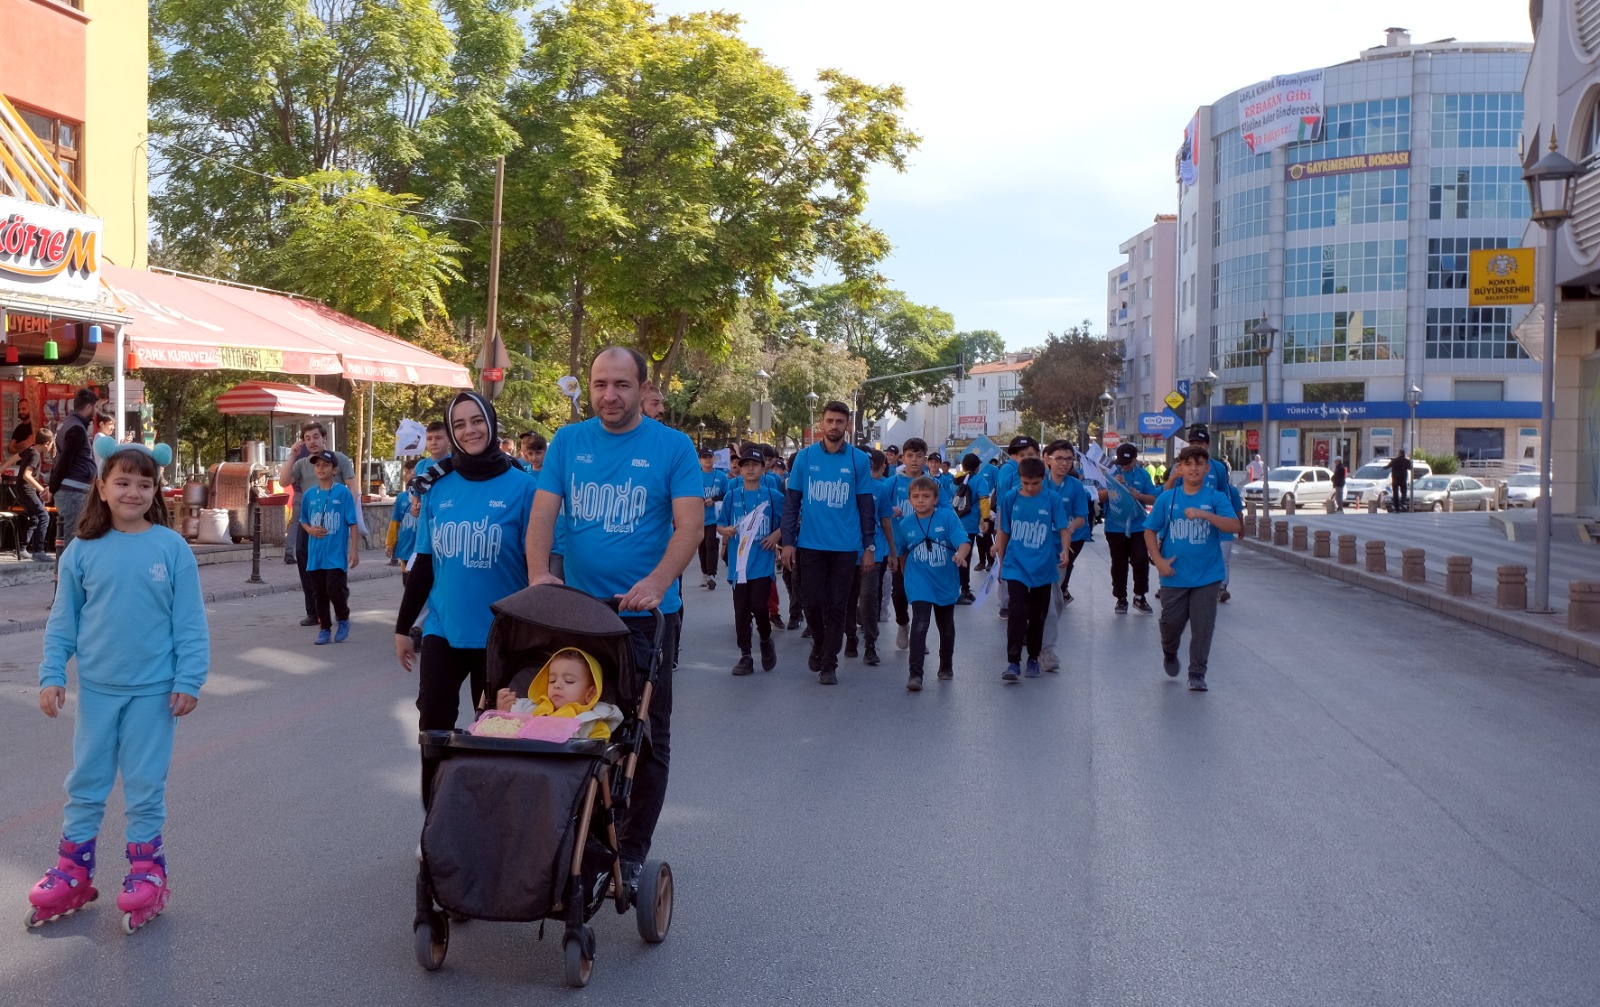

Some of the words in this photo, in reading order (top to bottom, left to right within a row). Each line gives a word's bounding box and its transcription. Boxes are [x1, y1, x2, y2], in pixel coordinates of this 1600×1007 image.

[1286, 89, 1312, 103] Gibi
[1368, 152, 1409, 167] BORSASI
[1474, 286, 1530, 295] BÜYÜKŞEHİR
[138, 347, 166, 362] PARK
[609, 524, 630, 533] 2023
[468, 560, 490, 569] 2023
